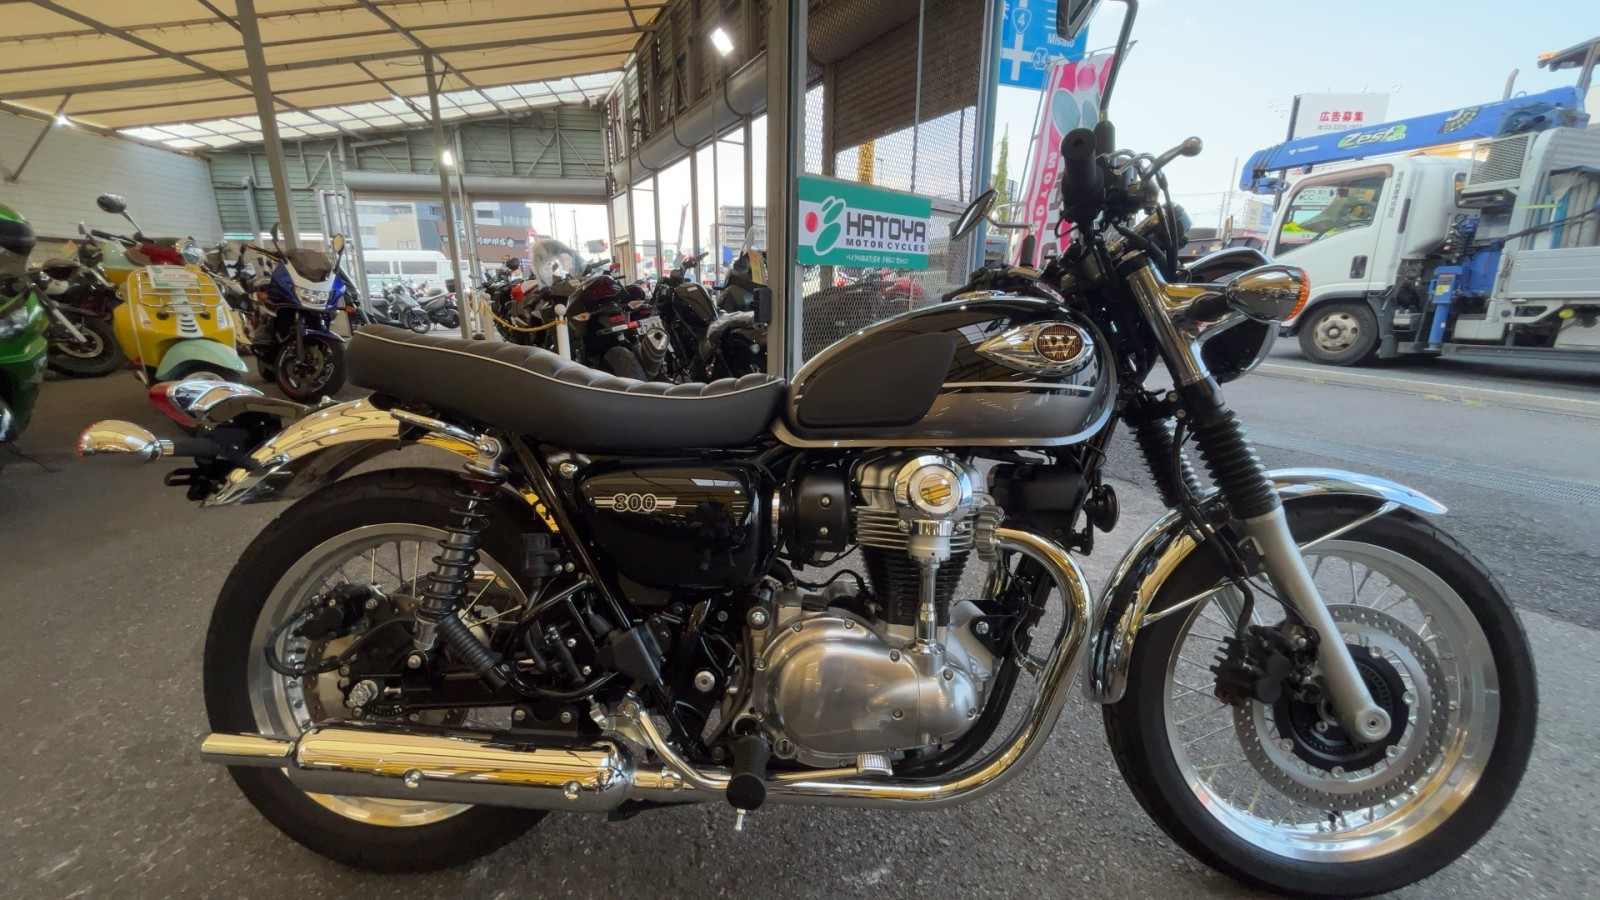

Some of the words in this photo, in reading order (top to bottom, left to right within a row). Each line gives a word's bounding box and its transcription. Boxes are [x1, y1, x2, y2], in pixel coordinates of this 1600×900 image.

[1017, 12, 1026, 27] 4
[1035, 52, 1047, 65] 34
[1319, 111, 1364, 122] 広告募集
[1342, 126, 1397, 147] Zest
[846, 212, 926, 243] HATOYA
[846, 238, 884, 249] MOTOR
[887, 242, 925, 252] CYCLES
[612, 493, 657, 512] 800
